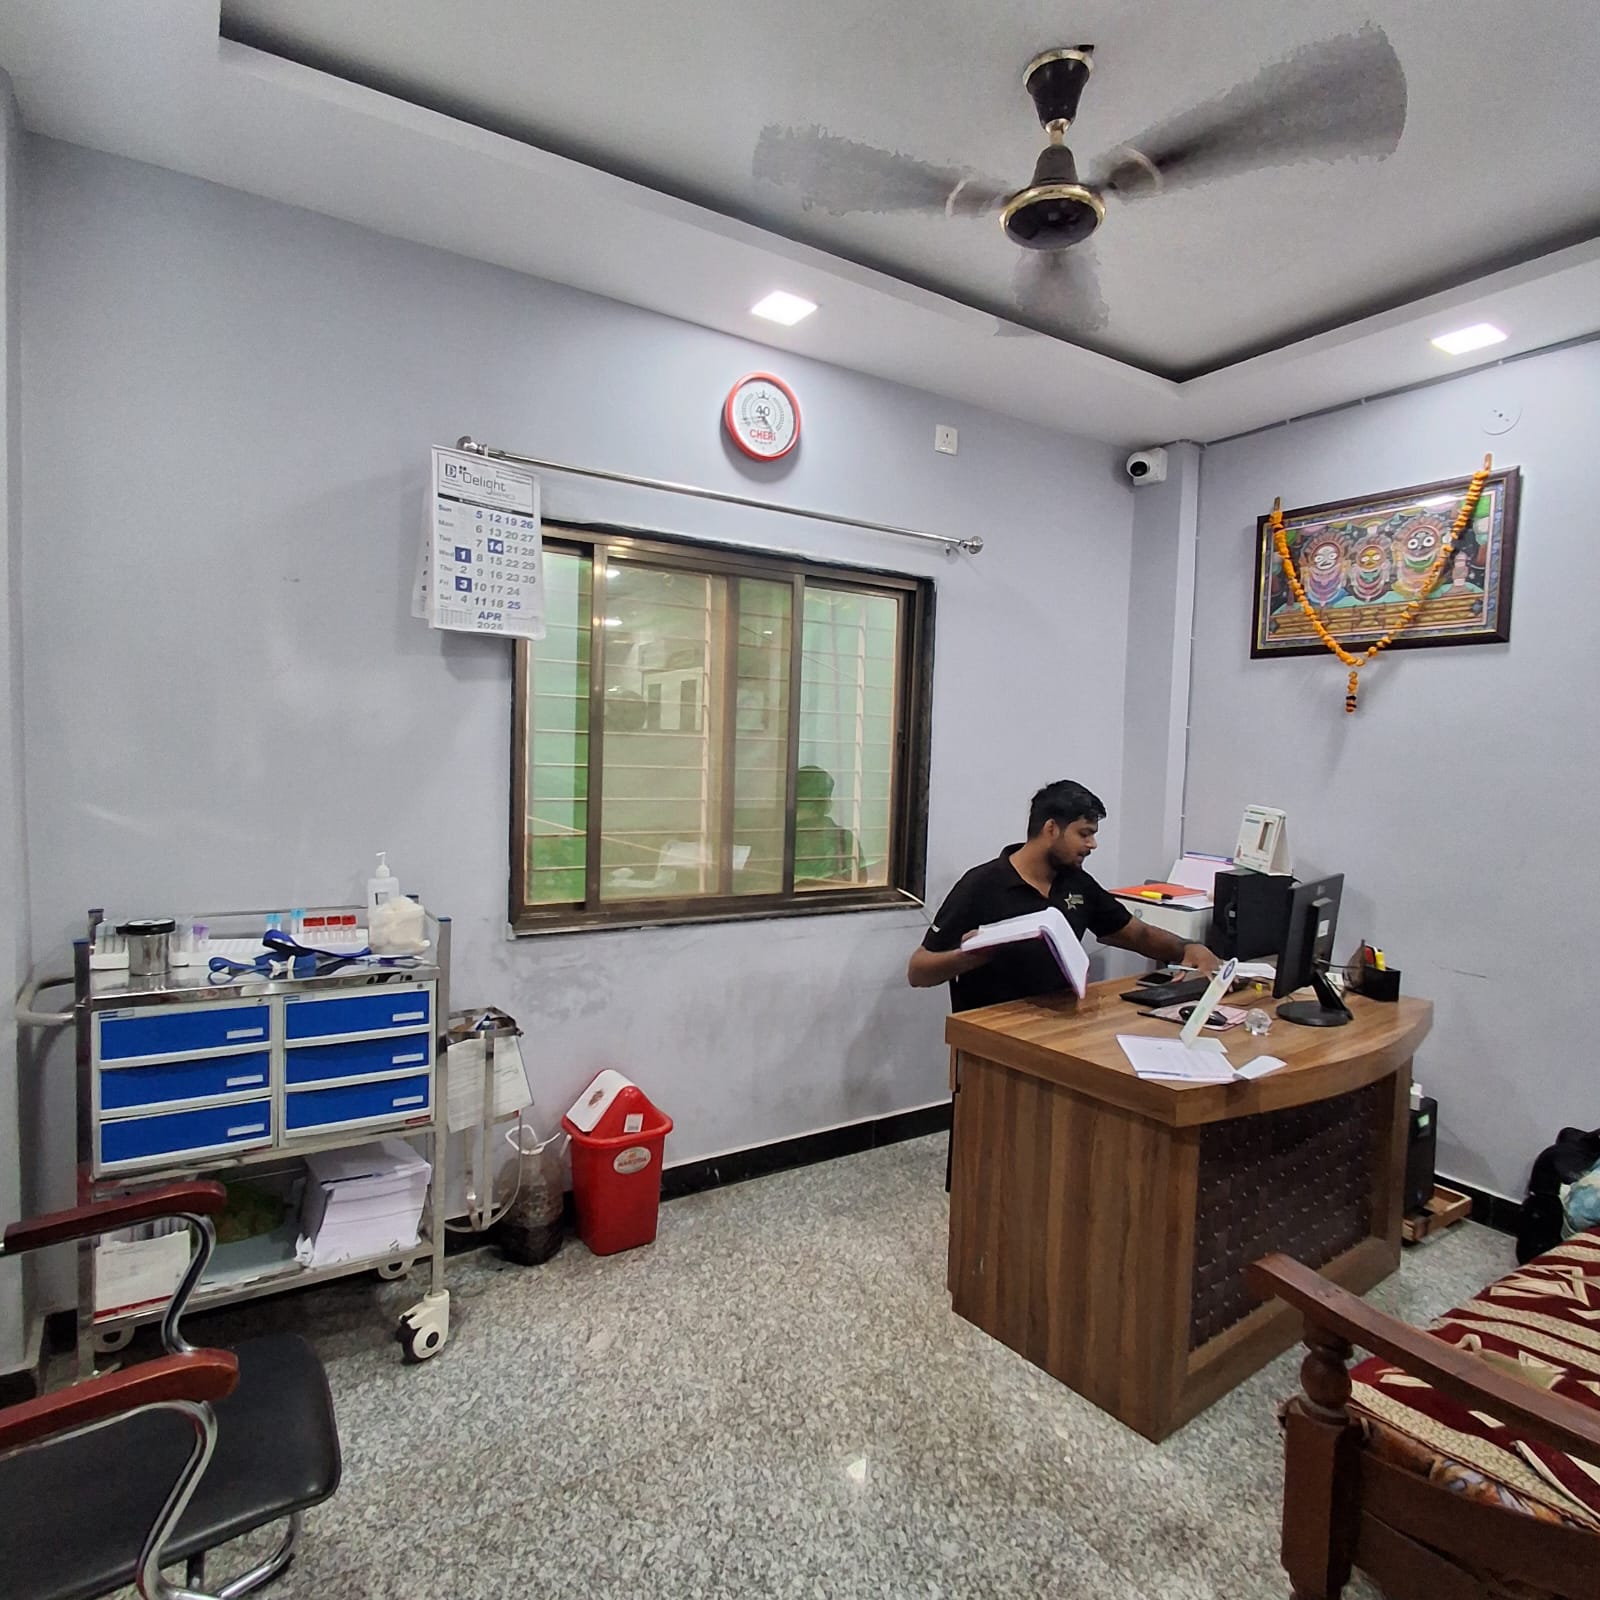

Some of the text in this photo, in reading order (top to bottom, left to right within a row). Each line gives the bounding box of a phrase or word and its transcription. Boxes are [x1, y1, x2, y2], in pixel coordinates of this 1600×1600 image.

[756, 405, 770, 416] 40
[463, 472, 506, 495] Delight
[476, 510, 482, 519] 5
[489, 514, 502, 523] 12
[505, 517, 517, 526] 19
[520, 520, 533, 529] 26
[476, 525, 482, 534] 6
[490, 528, 502, 537] 13
[505, 531, 518, 540] 20
[520, 534, 534, 542] 27
[489, 542, 502, 552] 14
[506, 545, 518, 554] 21
[521, 548, 535, 556] 28
[476, 554, 483, 562] 8
[490, 557, 502, 566] 15
[506, 560, 519, 568] 22
[522, 562, 535, 570] 29
[460, 566, 467, 574] 2
[477, 568, 483, 576] 9
[491, 571, 503, 580] 16
[506, 573, 519, 582] 23
[522, 576, 536, 584] 30
[474, 582, 487, 592] 10
[490, 585, 503, 593] 17
[507, 587, 520, 596] 24
[474, 597, 487, 606] 11
[491, 599, 504, 608] 18
[507, 601, 520, 610] 25
[478, 611, 502, 621] APR
